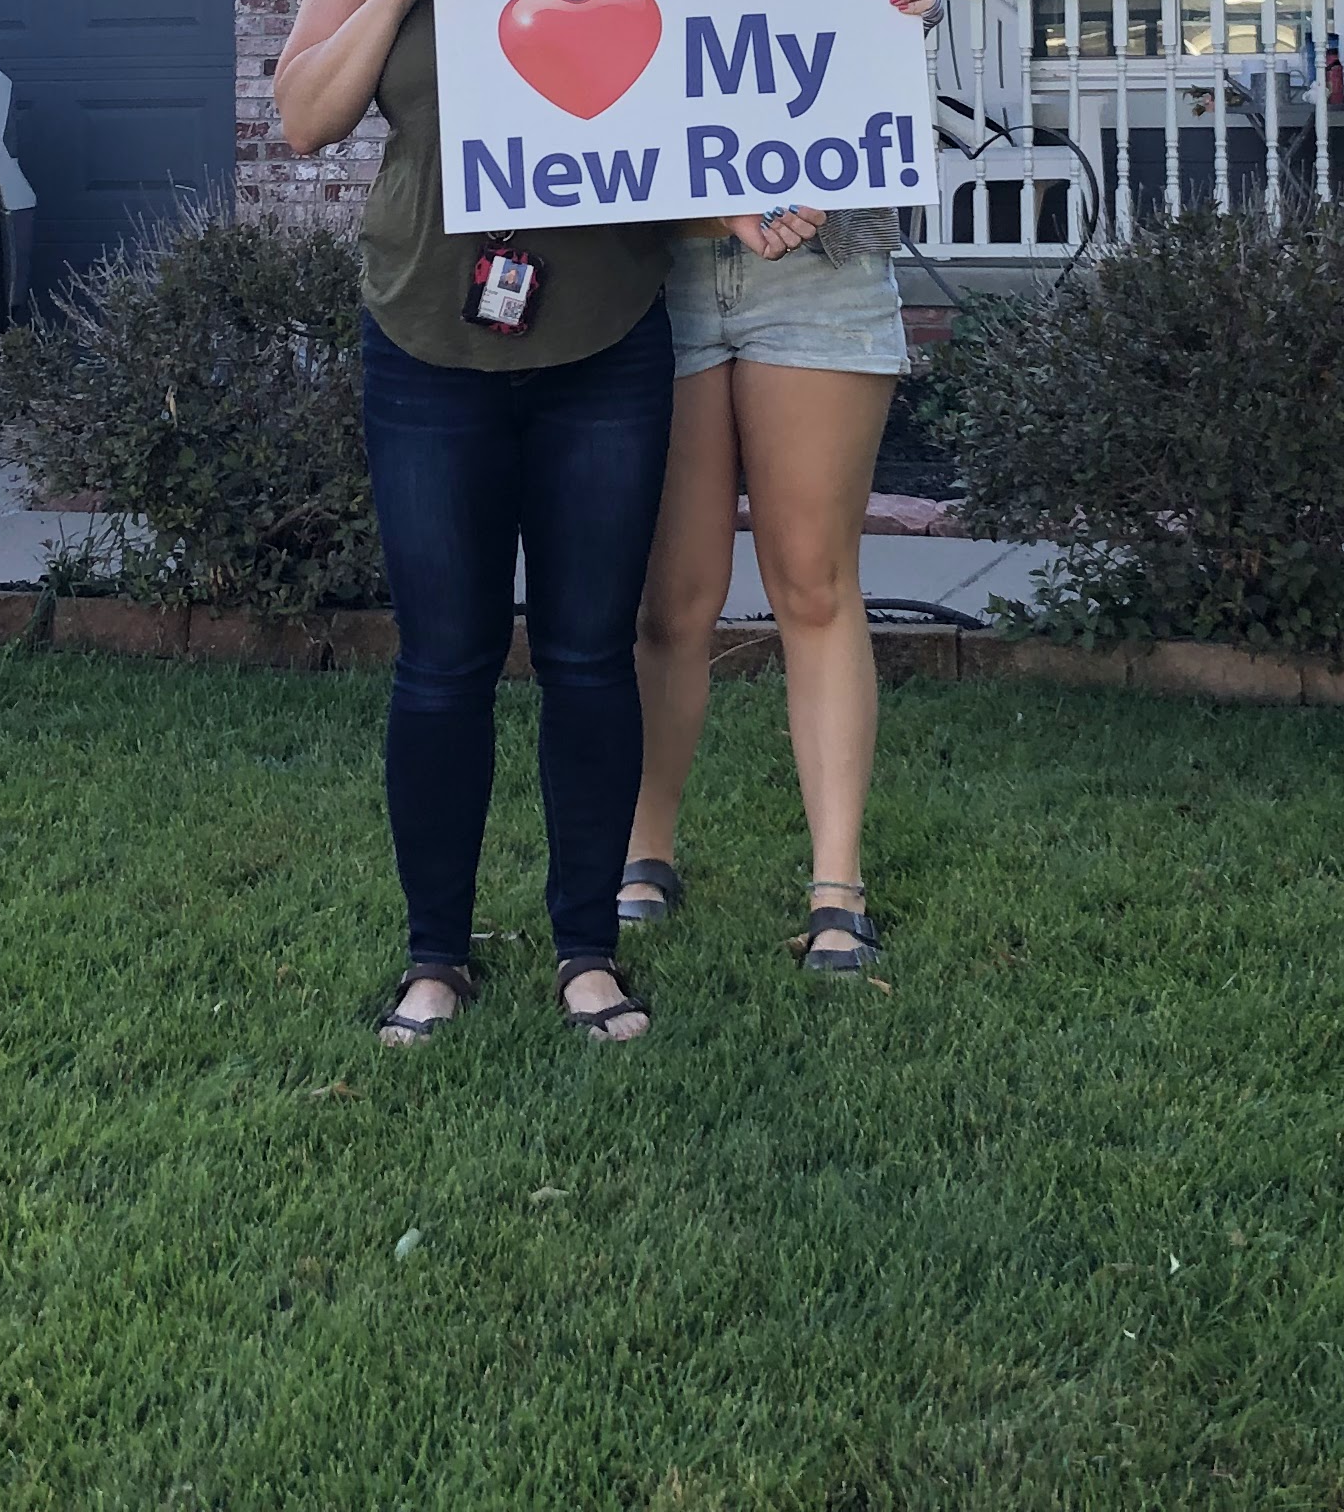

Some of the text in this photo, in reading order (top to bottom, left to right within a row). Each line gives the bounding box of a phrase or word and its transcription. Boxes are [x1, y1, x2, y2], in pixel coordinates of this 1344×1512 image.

[685, 12, 837, 119] My
[461, 111, 921, 213] New Roof!
